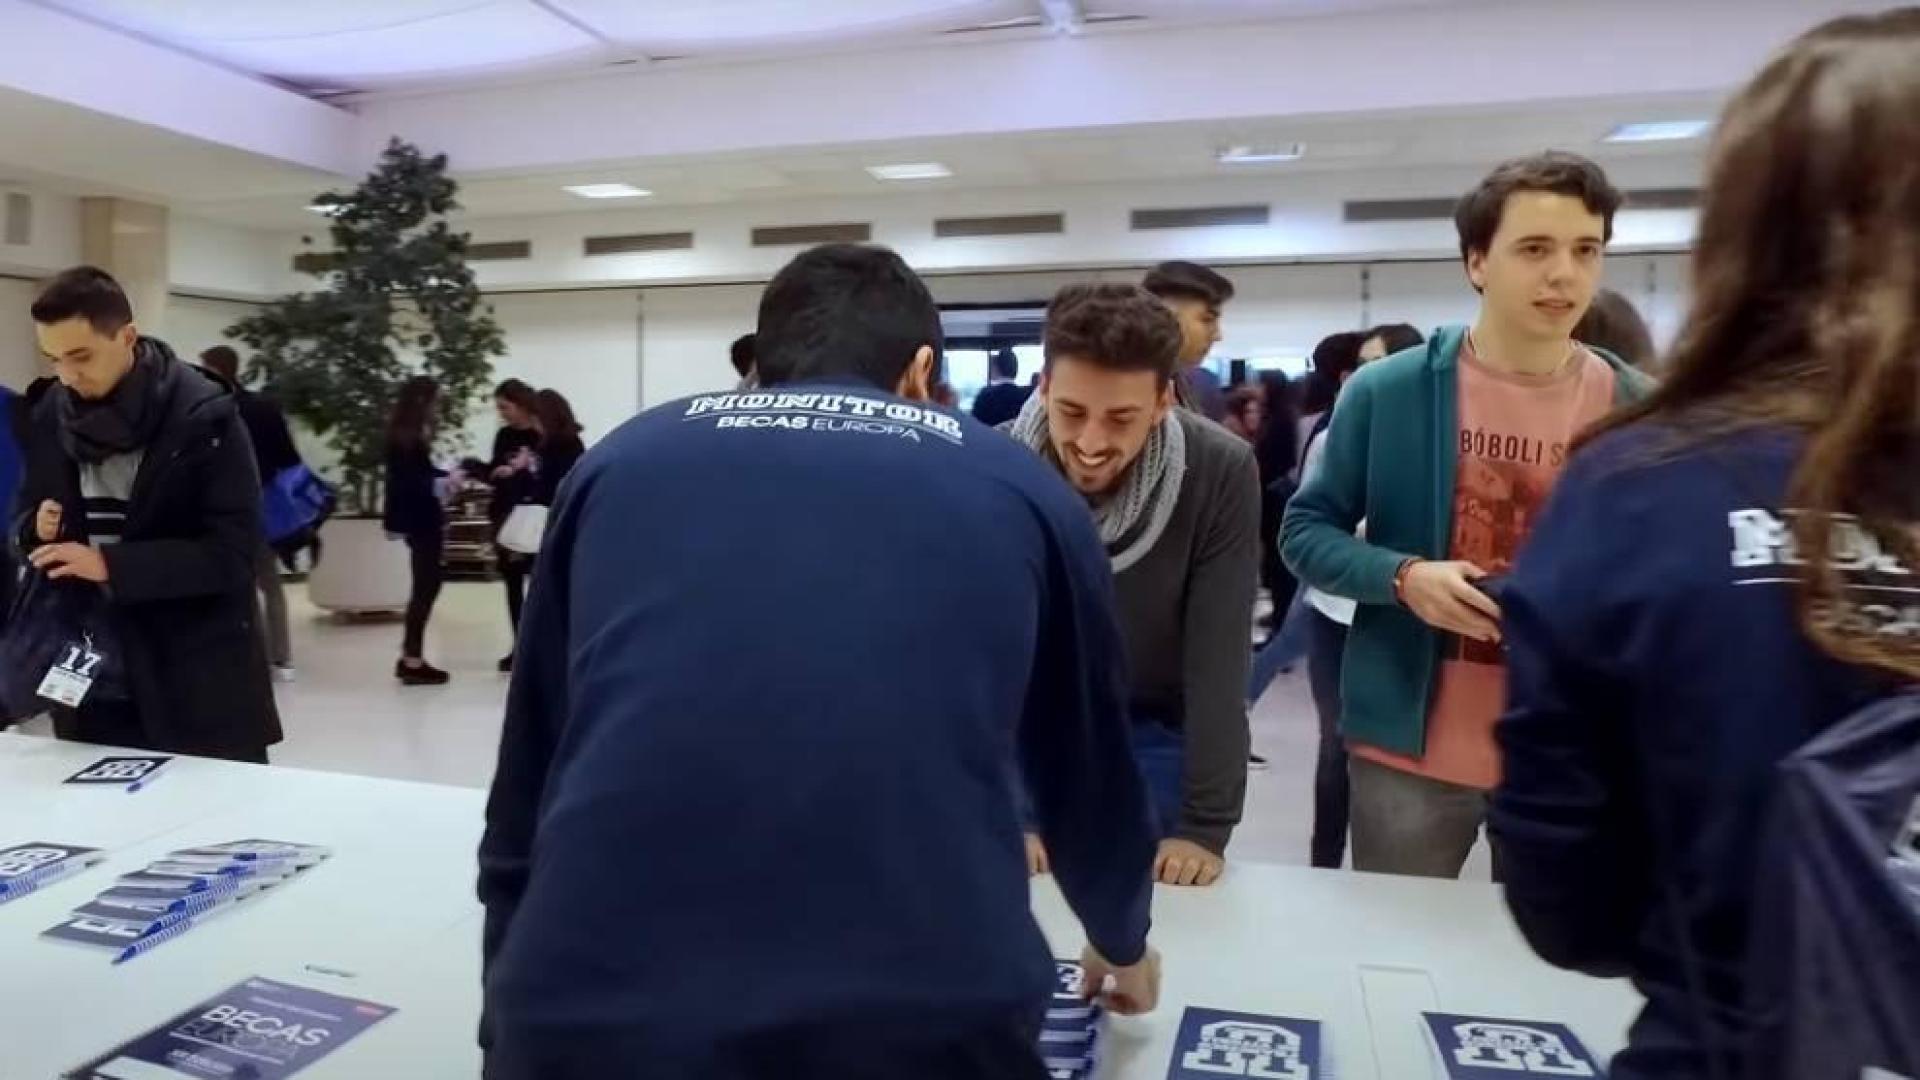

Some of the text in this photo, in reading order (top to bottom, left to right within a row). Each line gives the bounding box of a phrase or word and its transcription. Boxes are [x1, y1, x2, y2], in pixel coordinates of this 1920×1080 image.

[685, 394, 963, 438] MONITOR
[717, 415, 921, 442] BECAS EUROPA
[1460, 427, 1542, 465] BÓBOLI
[61, 647, 101, 675] 17
[201, 1005, 331, 1046] BECAS
